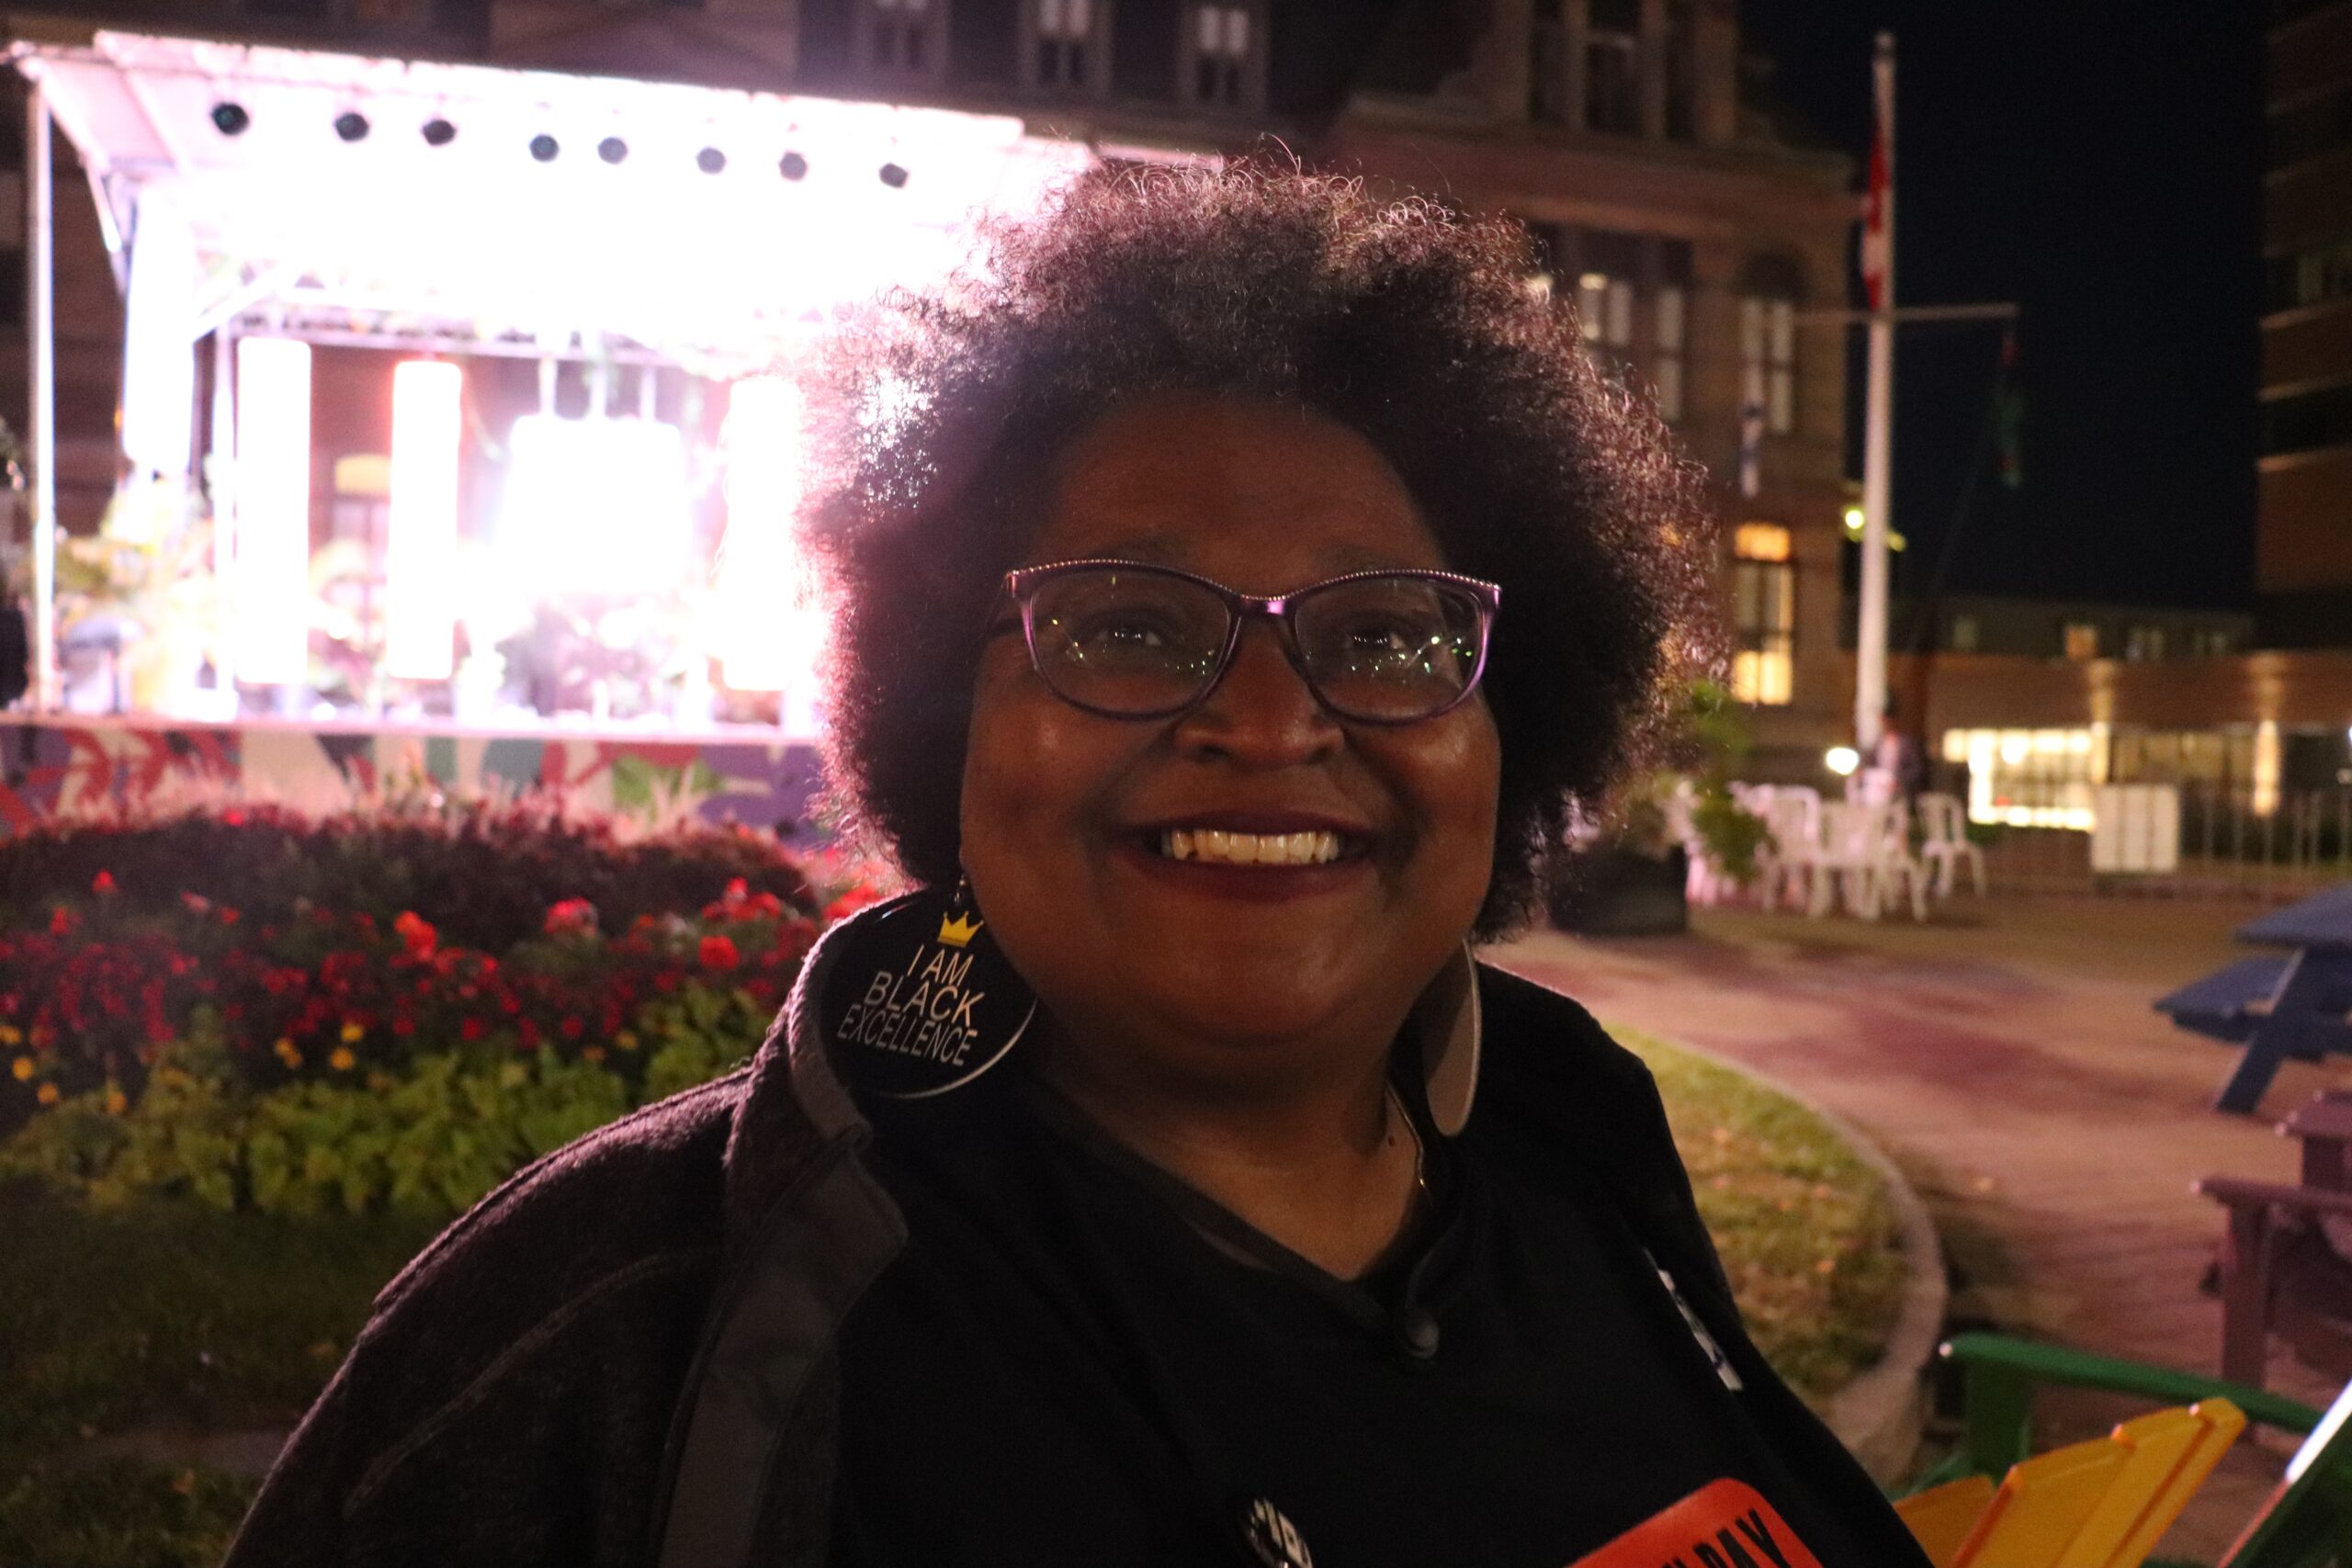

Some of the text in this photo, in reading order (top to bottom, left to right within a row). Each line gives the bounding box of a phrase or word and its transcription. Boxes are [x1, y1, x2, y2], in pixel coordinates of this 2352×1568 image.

[907, 944, 974, 987] I AM
[864, 971, 985, 1027] BLACK
[837, 1003, 978, 1066] EXCELLENCE
